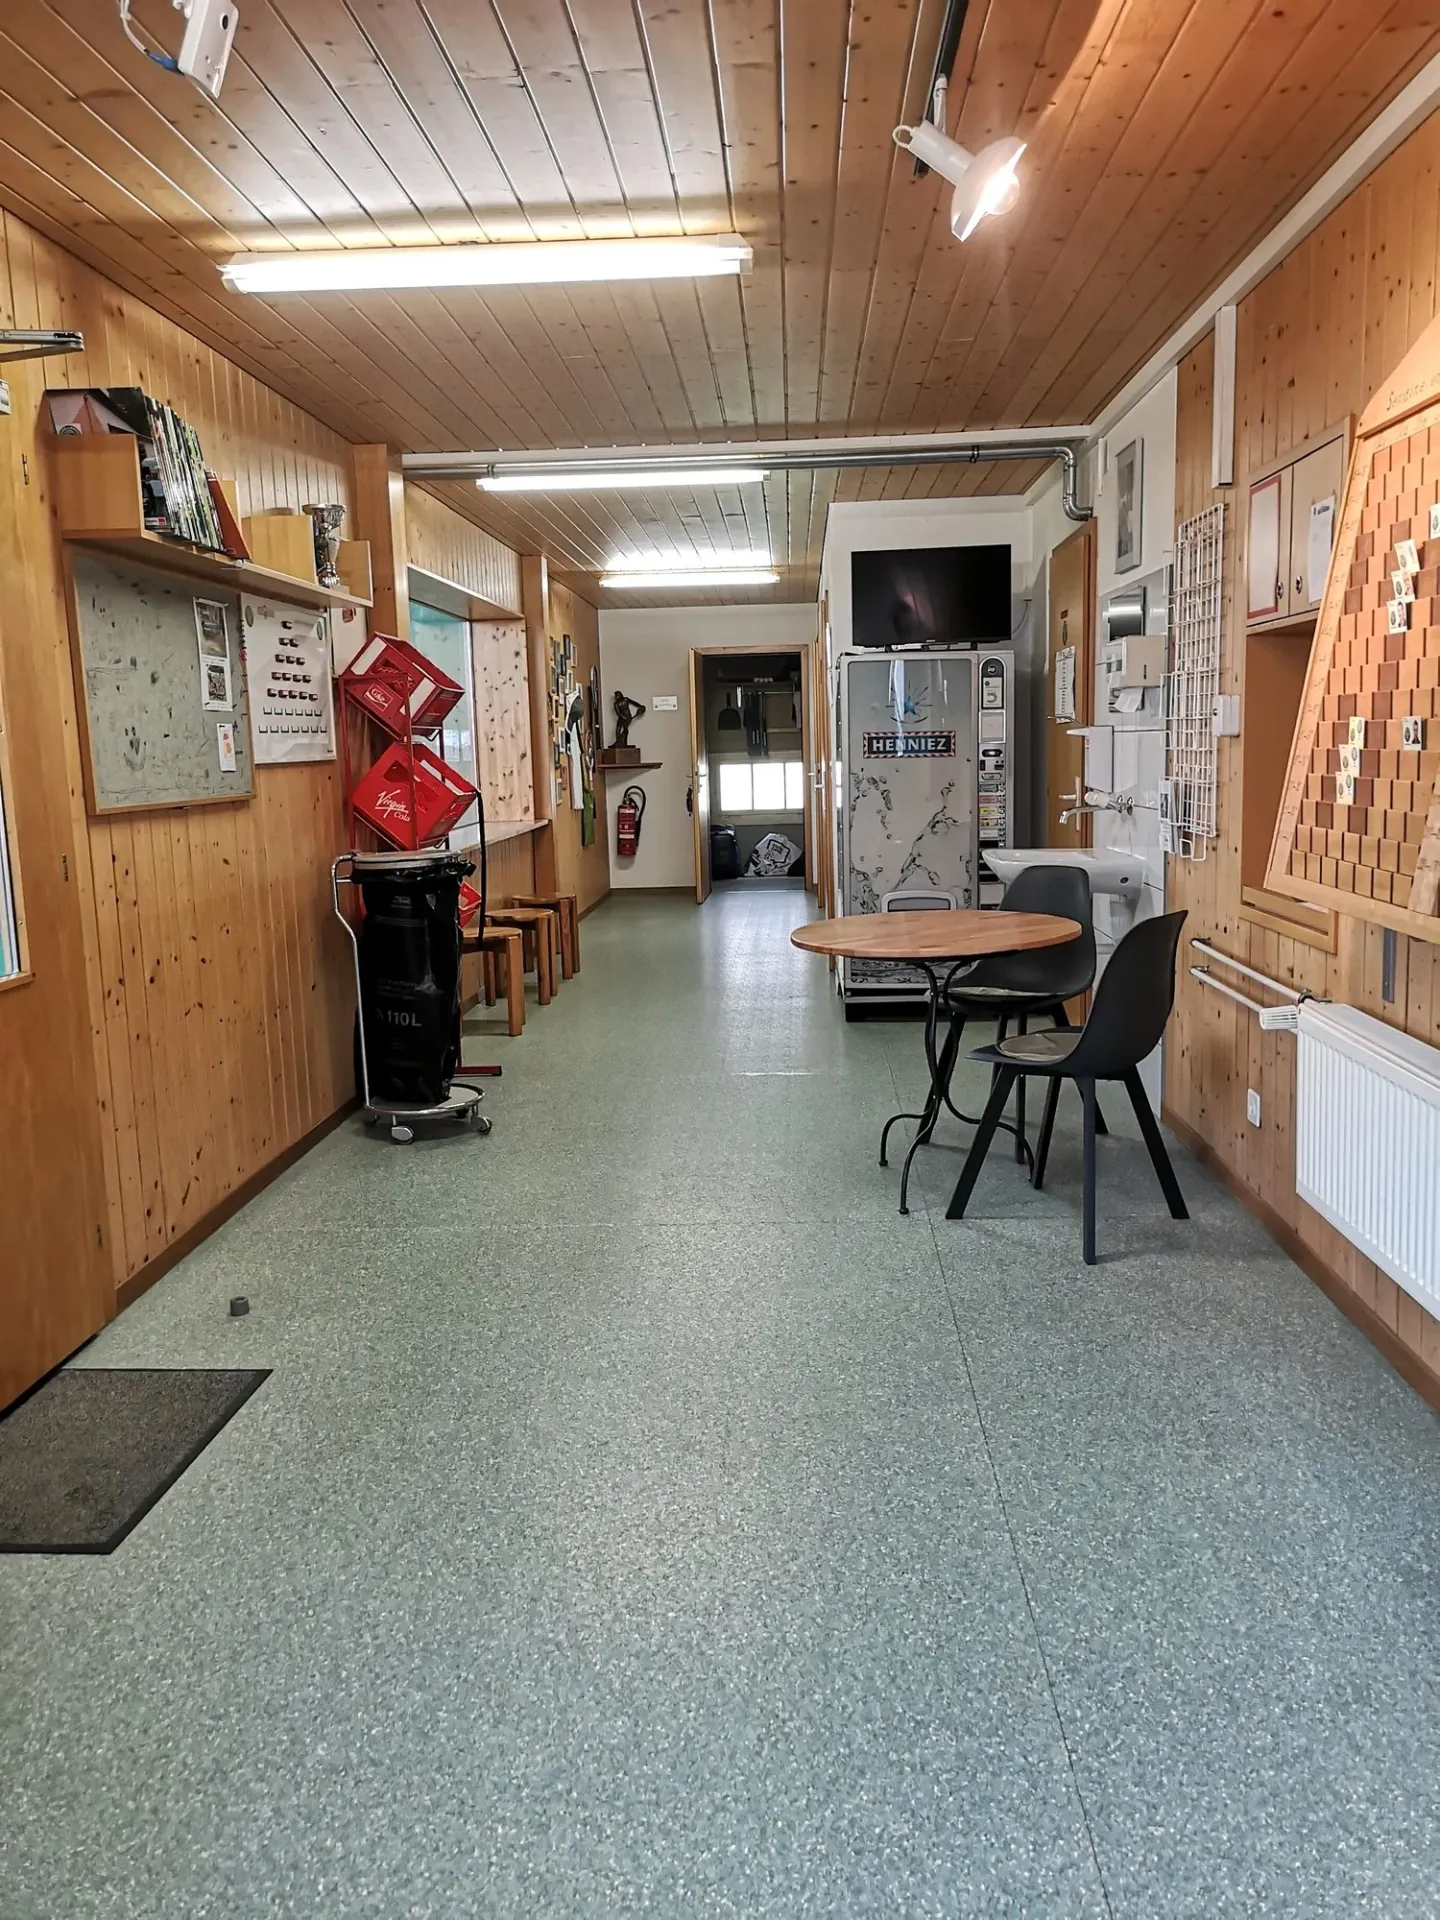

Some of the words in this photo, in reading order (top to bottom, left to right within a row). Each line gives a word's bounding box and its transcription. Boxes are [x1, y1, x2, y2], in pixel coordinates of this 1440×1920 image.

[872, 737, 947, 752] HENNIEZ
[374, 789, 409, 819] Virgin
[393, 811, 411, 822] Cola
